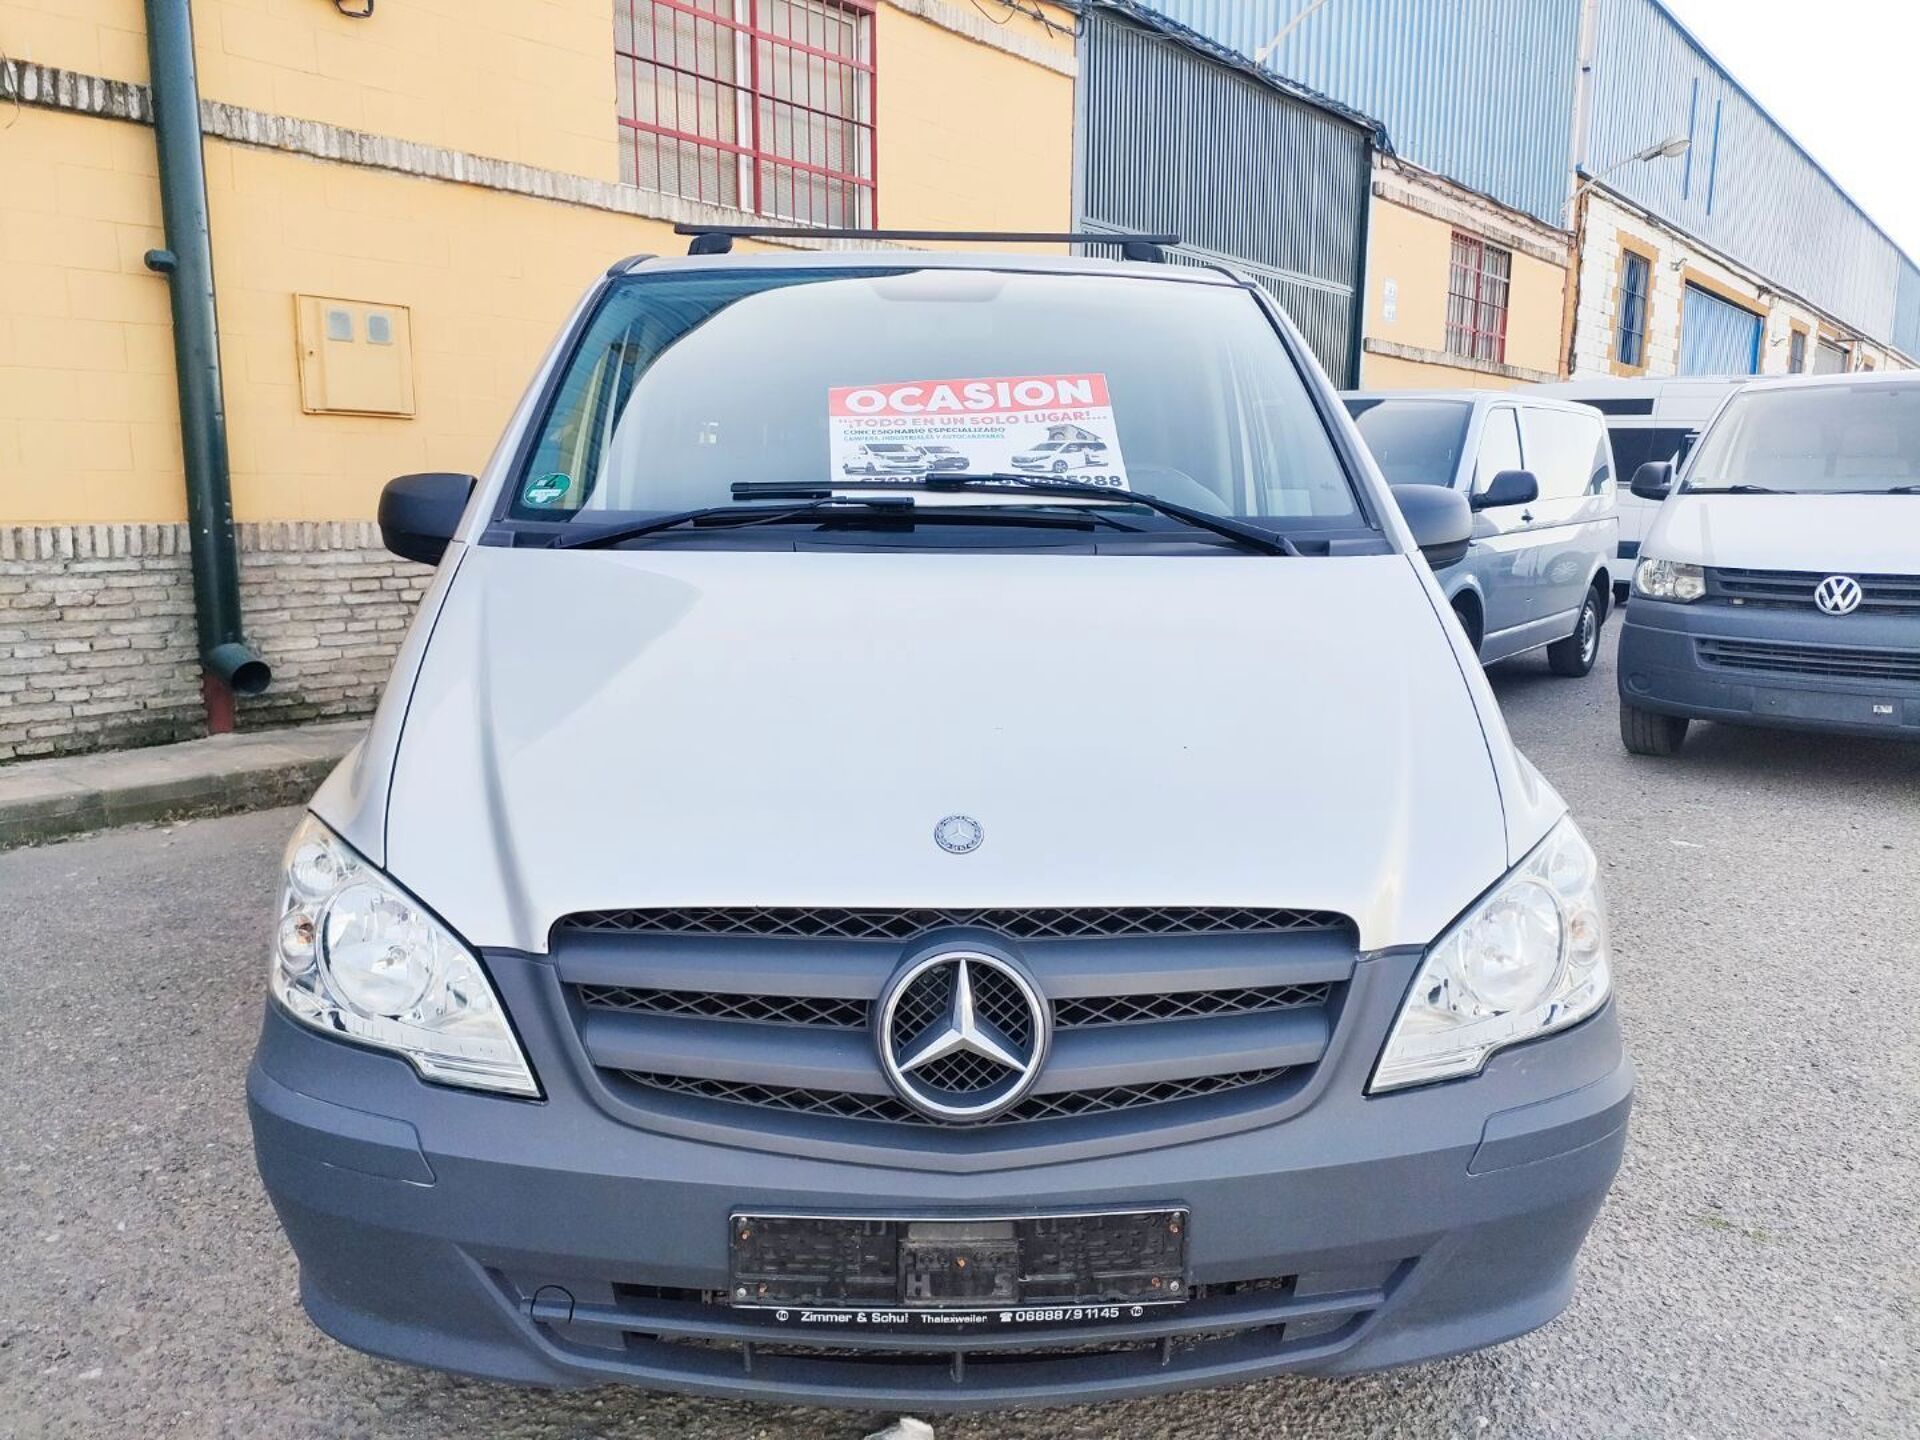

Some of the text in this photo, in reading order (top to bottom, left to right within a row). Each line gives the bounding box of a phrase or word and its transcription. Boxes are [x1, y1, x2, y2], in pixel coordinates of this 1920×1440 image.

[845, 379, 1094, 414] OCASION
[911, 417, 934, 427] EN
[940, 415, 965, 426] UN
[969, 414, 1019, 425] SOLO
[843, 427, 926, 436] CONCESIONARIO
[543, 474, 559, 489] 4
[801, 1311, 852, 1323] Zimmer
[856, 1312, 869, 1323] &
[920, 1314, 988, 1324] Thalexweiler
